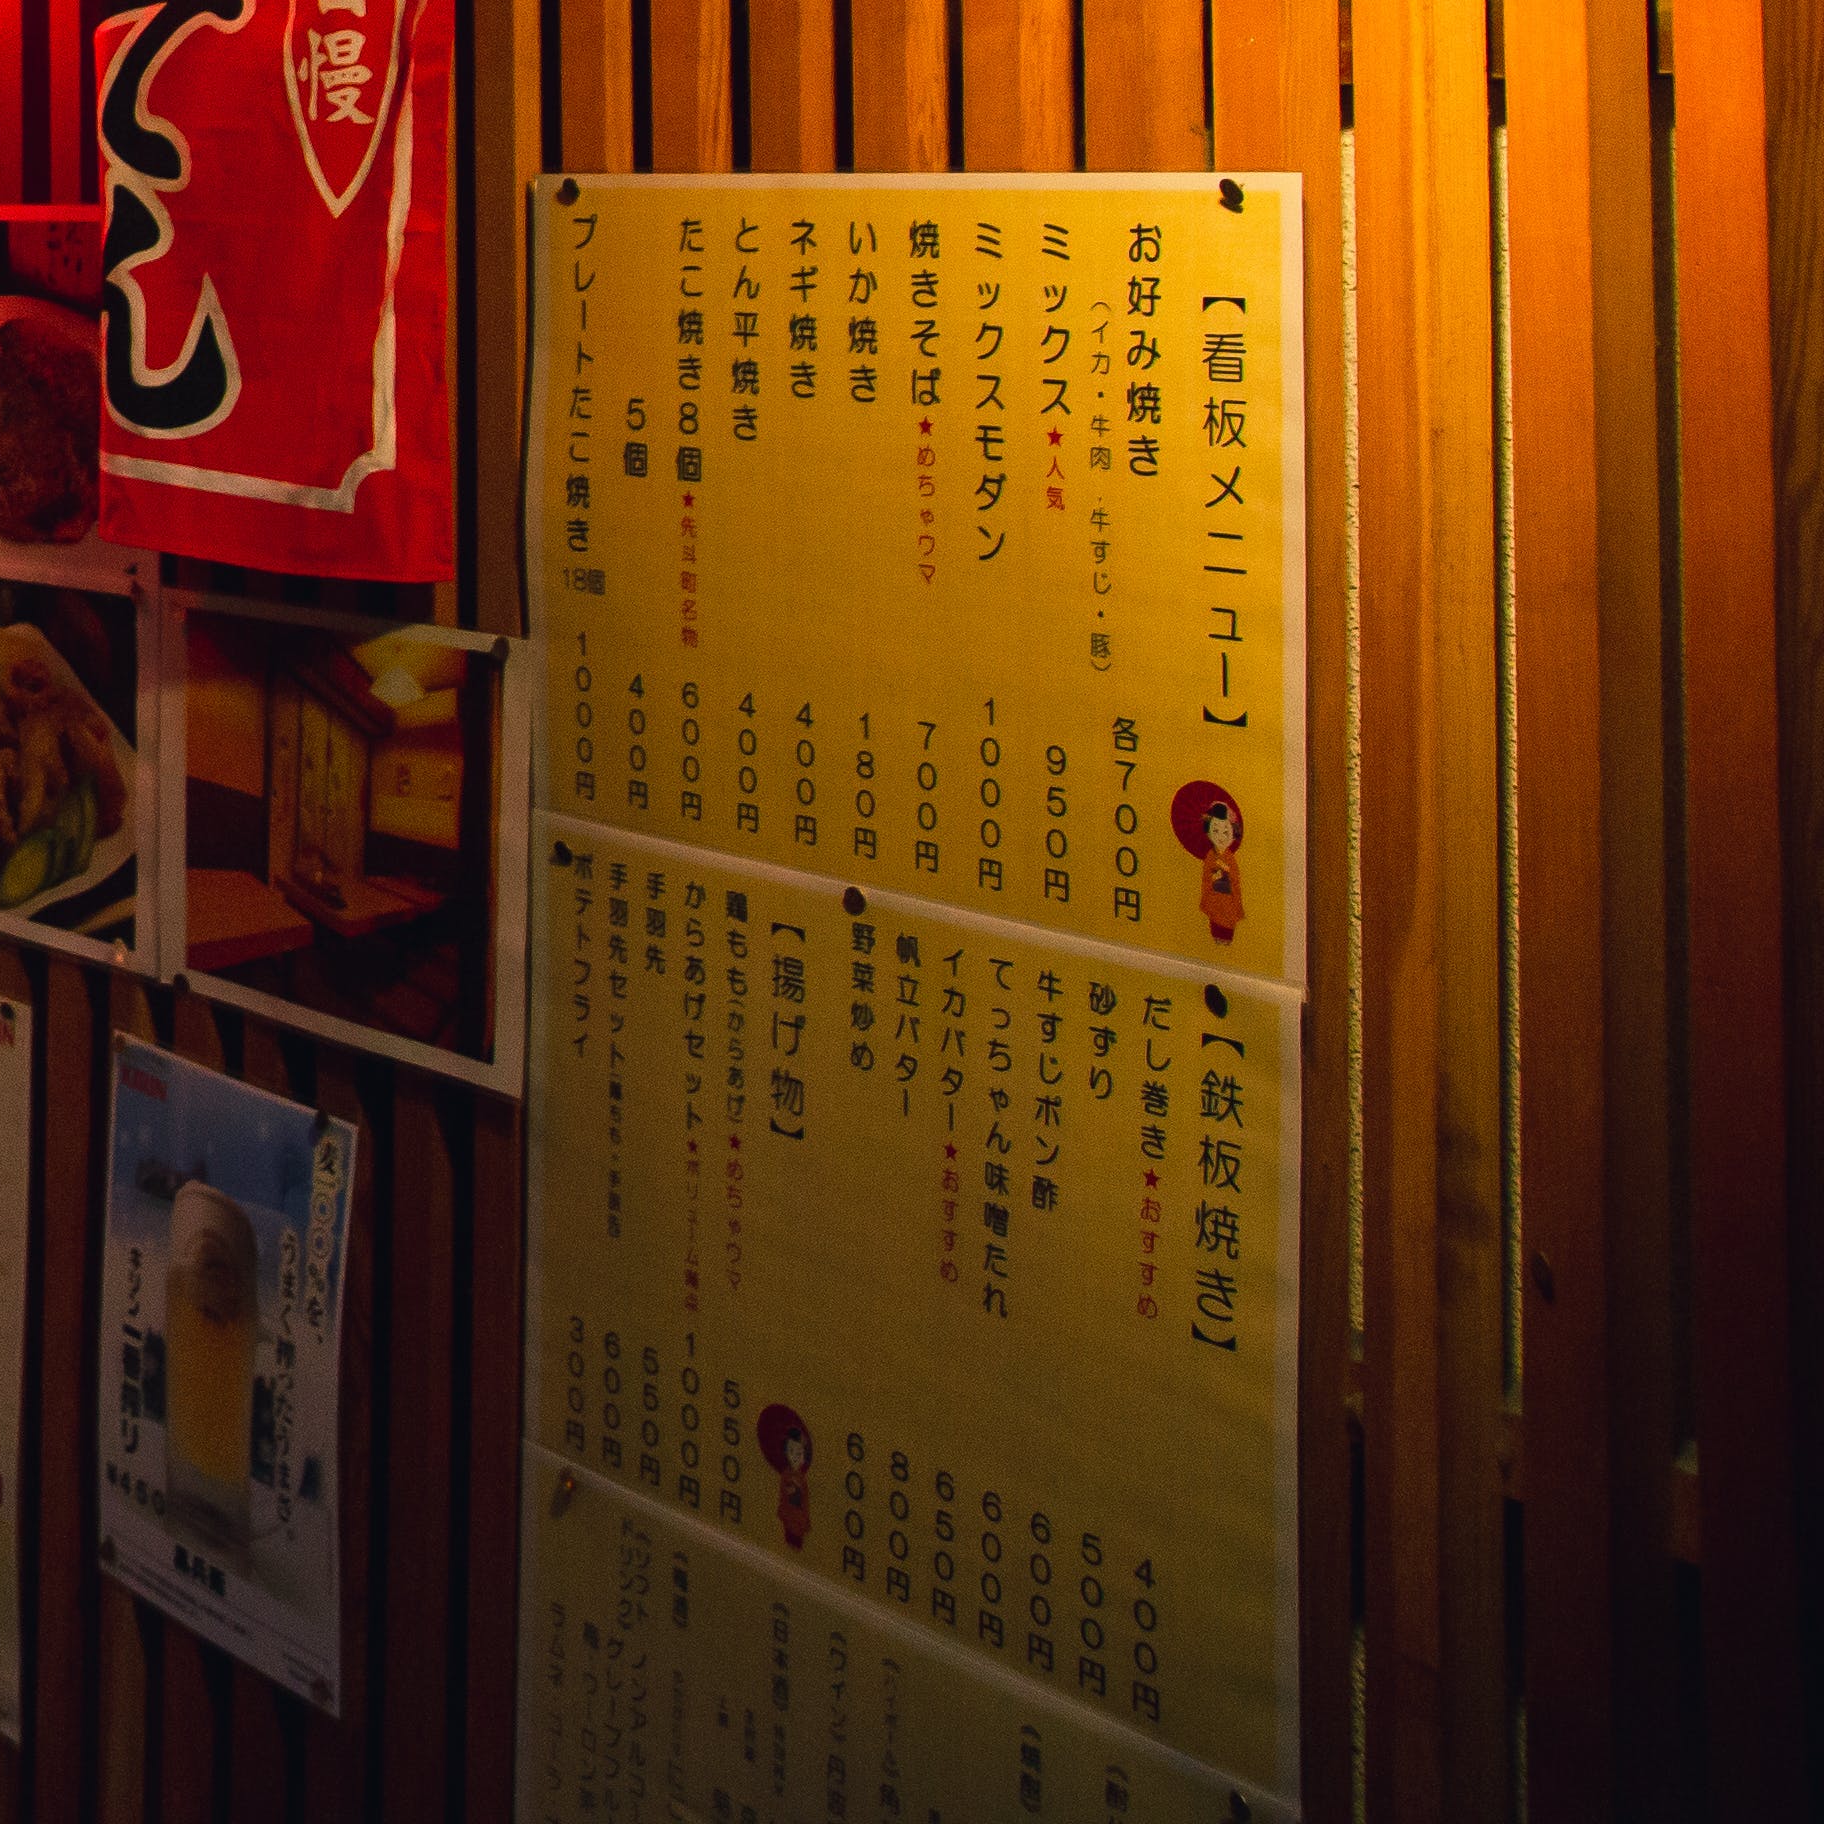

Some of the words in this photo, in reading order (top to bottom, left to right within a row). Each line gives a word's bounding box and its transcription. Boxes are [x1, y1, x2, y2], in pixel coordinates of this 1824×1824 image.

[564, 212, 599, 555] プレートたこ焼き
[673, 216, 706, 484] たこ焼き8個
[729, 216, 762, 443] とん平焼き
[787, 217, 819, 401] ネギ焼き
[846, 220, 879, 405] いか焼き
[907, 219, 943, 408] 焼きそば
[973, 221, 1008, 563] ミックスモダン
[1039, 221, 1072, 416] ミックス
[1124, 221, 1163, 479] お好み焼き
[621, 396, 650, 480] 5個
[915, 444, 937, 586] めちゃウマ
[1044, 455, 1067, 513] 人気
[1200, 294, 1249, 731] 【看板メニュー】
[566, 630, 597, 805] 1000円
[621, 673, 651, 815] 400円
[678, 680, 705, 827] 600円
[733, 691, 761, 836] 400円
[791, 701, 820, 848] 400円
[851, 711, 879, 862] 180円
[913, 719, 941, 876] 700円
[975, 696, 1006, 893] 1000円
[1041, 743, 1072, 907] 950円
[1110, 715, 1143, 925] 各700円
[644, 870, 668, 976] 手羽先
[681, 878, 708, 1131] からあげセット
[848, 917, 877, 1073] 野菜炒め
[767, 920, 808, 1142] 【揚げ物】
[889, 930, 923, 1118] 帆立バター
[939, 947, 967, 1133] イカバター
[1029, 967, 1065, 1214] 牛すじポン酢
[1086, 979, 1119, 1101] 砂ずり
[1139, 993, 1173, 1162] だし巻き
[980, 956, 1015, 1320] てっちゃん味噌たれ
[1189, 1030, 1247, 1357] 【鉄板焼き】
[1135, 1195, 1163, 1321] おすすめ
[675, 1331, 705, 1512] 1000円
[717, 1378, 747, 1527] 550円
[839, 1431, 869, 1585] 600円
[881, 1449, 915, 1607] 800円
[927, 1469, 959, 1631] 650円
[975, 1489, 1009, 1652] 600円
[1023, 1510, 1059, 1677] 600円
[1073, 1531, 1110, 1702] 500円
[1127, 1557, 1165, 1727] 400円
